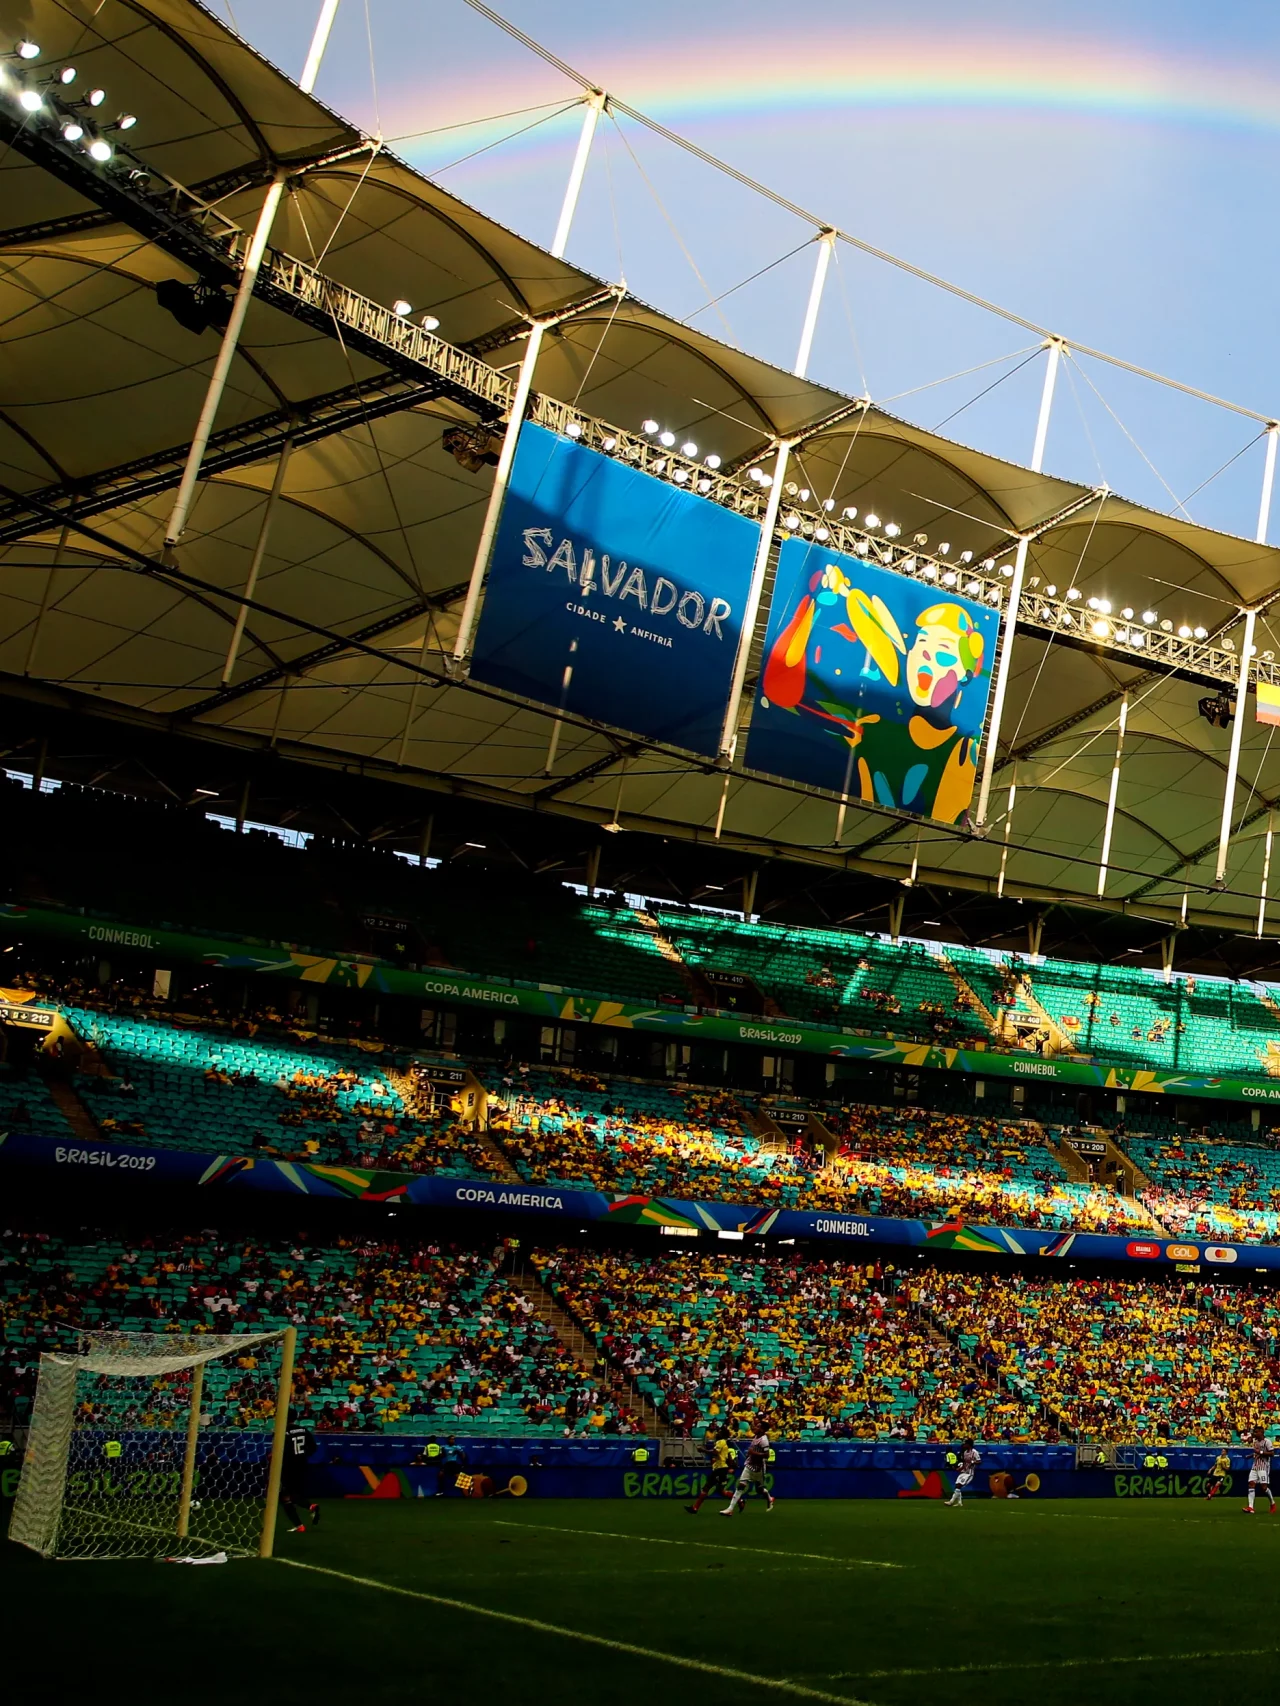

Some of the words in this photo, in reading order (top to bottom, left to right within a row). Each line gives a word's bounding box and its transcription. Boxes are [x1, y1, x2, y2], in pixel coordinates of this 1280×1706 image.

[522, 527, 732, 640] SALVADOR
[566, 602, 606, 624] CIDADE
[631, 626, 673, 648] ANFITRIÃ
[731, 976, 744, 984] 410
[424, 981, 460, 997] COPA
[462, 986, 520, 1005] AMERICA
[32, 1013, 51, 1023] 212
[778, 1032, 802, 1044] 2019
[449, 1071, 463, 1081] 211
[1242, 1087, 1268, 1099] COPA
[791, 1113, 804, 1121] 210
[1091, 1143, 1104, 1152] 208
[117, 1154, 157, 1171] 2019
[455, 1188, 496, 1204] COPA
[498, 1192, 564, 1210] AMERICA
[1173, 1247, 1193, 1258] GOL
[291, 1435, 305, 1455] 12
[1188, 1474, 1233, 1495] 209
